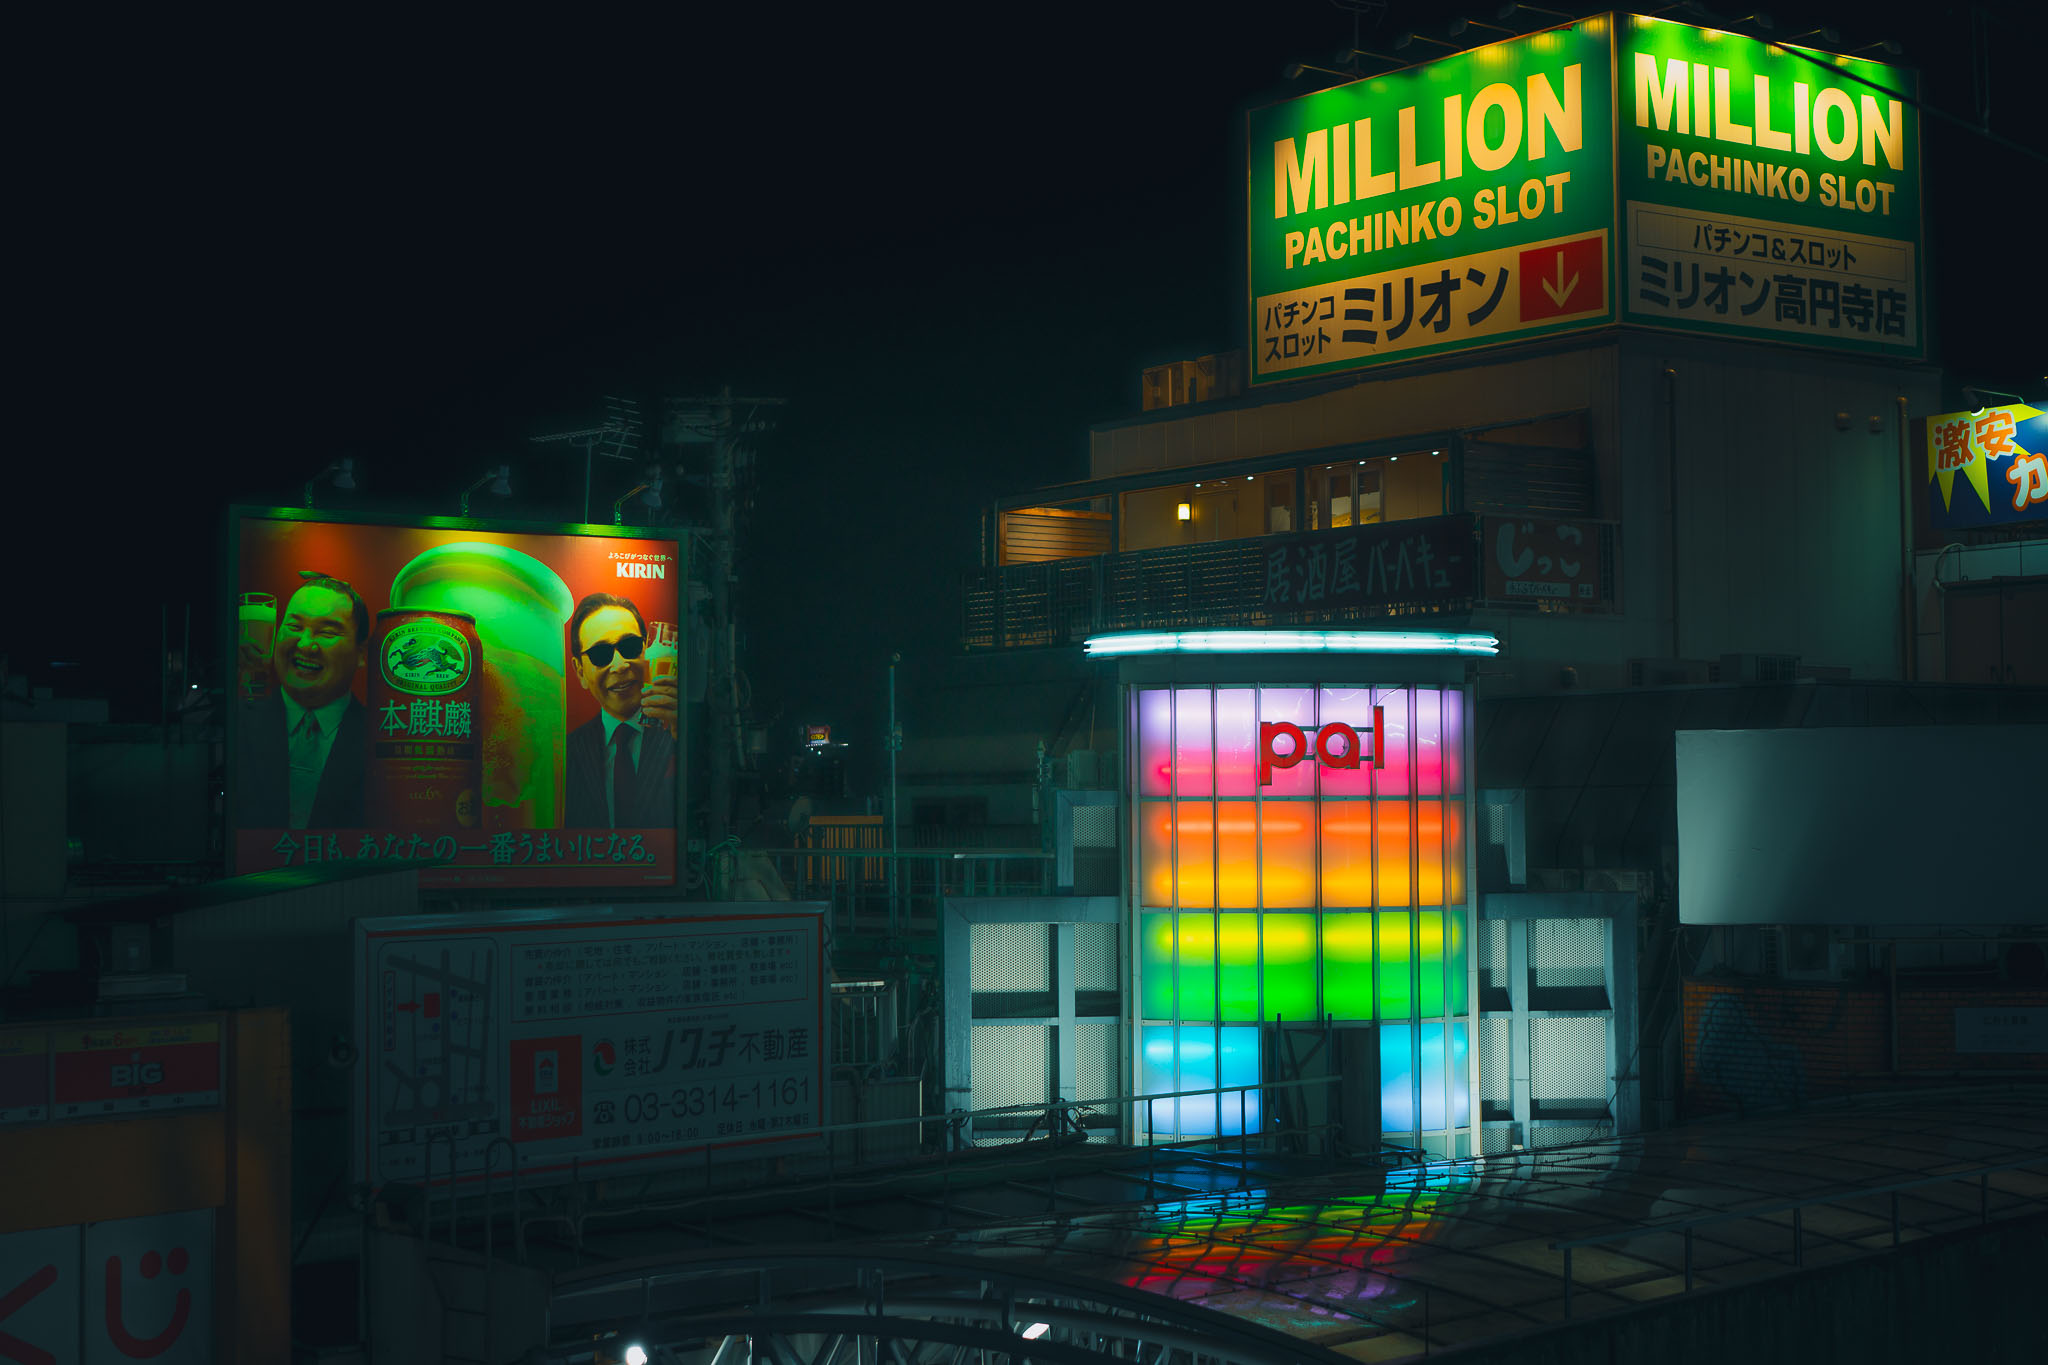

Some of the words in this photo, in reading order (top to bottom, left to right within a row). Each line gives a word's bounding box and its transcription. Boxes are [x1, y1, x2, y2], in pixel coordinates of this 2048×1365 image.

[1274, 63, 1583, 219] MILLION
[1635, 51, 1904, 171] MILLION
[1647, 144, 1810, 203] PACHINKO
[1819, 173, 1895, 216] SLOT
[1285, 197, 1463, 270] PACHINKO
[1473, 171, 1571, 230] SLOT
[1265, 295, 1335, 331] パチンコ
[1342, 267, 1509, 345] ミリオン
[1640, 255, 1906, 338] ミリオン高円寺店
[1265, 327, 1331, 362] スロット
[1934, 410, 2015, 470] 激安
[616, 562, 665, 579] KIRIN
[379, 699, 472, 739] 本麒麟
[1260, 705, 1385, 786] pal
[624, 1035, 652, 1056] 株式
[624, 1057, 652, 1077] 会社
[624, 1076, 809, 1124] 03-3314-1161
